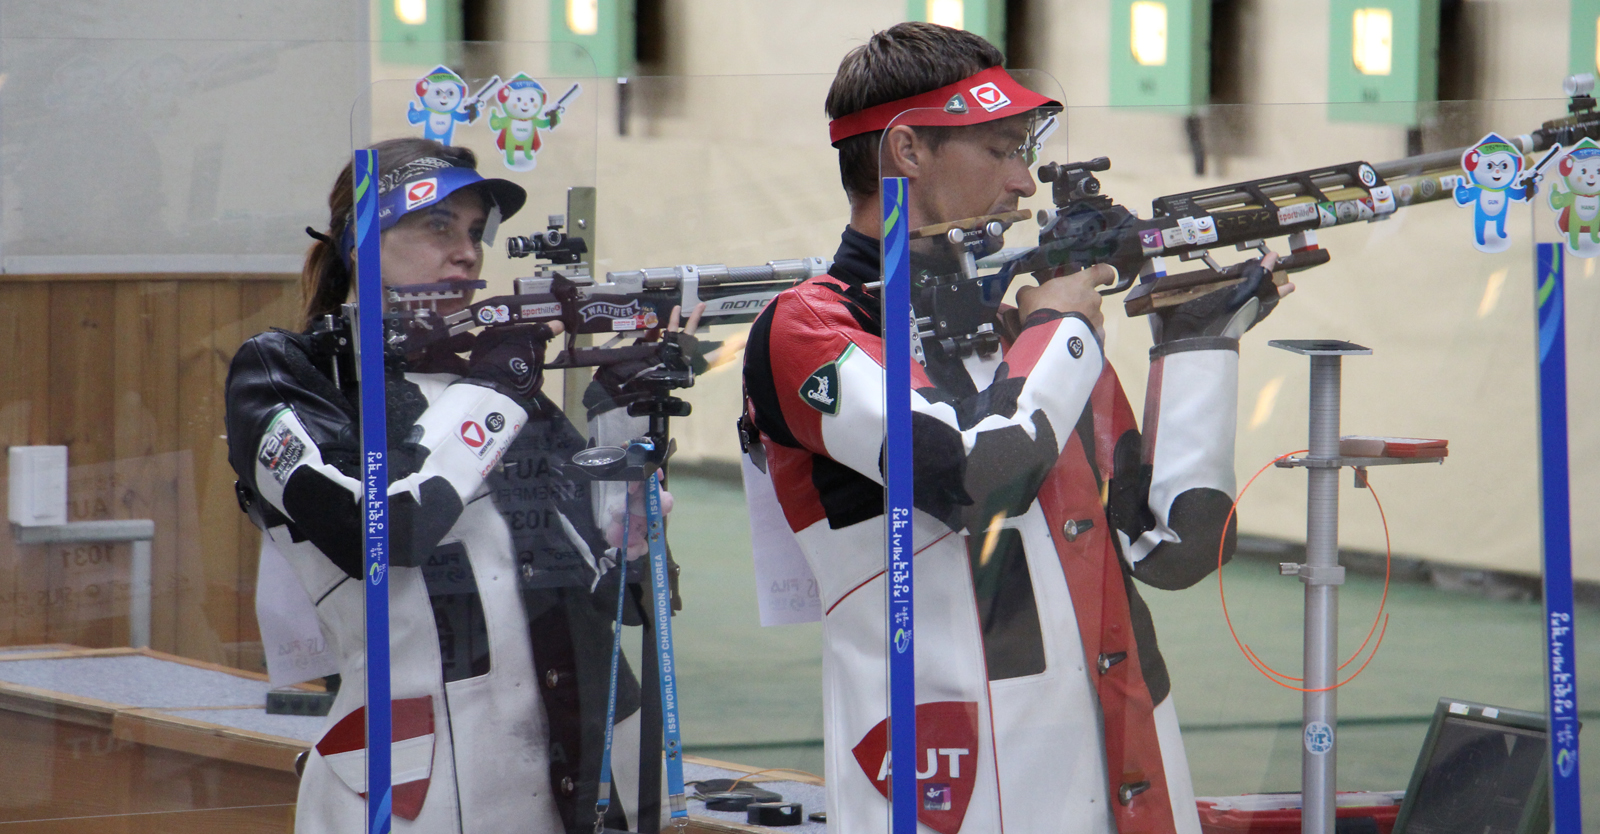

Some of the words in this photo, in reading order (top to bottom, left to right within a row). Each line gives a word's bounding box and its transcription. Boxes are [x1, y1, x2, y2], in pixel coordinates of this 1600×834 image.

[963, 239, 984, 247] SPORT
[522, 306, 555, 316] sporthilfe
[587, 305, 634, 317] WALTHER
[367, 451, 385, 534] 창원국제사격장
[649, 471, 657, 493] WO
[650, 494, 659, 516] ISSF
[893, 507, 909, 597] 창원국제사격장
[654, 554, 666, 589] KOREA
[657, 589, 671, 651] CHANGWON,
[662, 652, 672, 674] CUP
[664, 675, 675, 711] WORLD
[667, 712, 677, 733] ISSF
